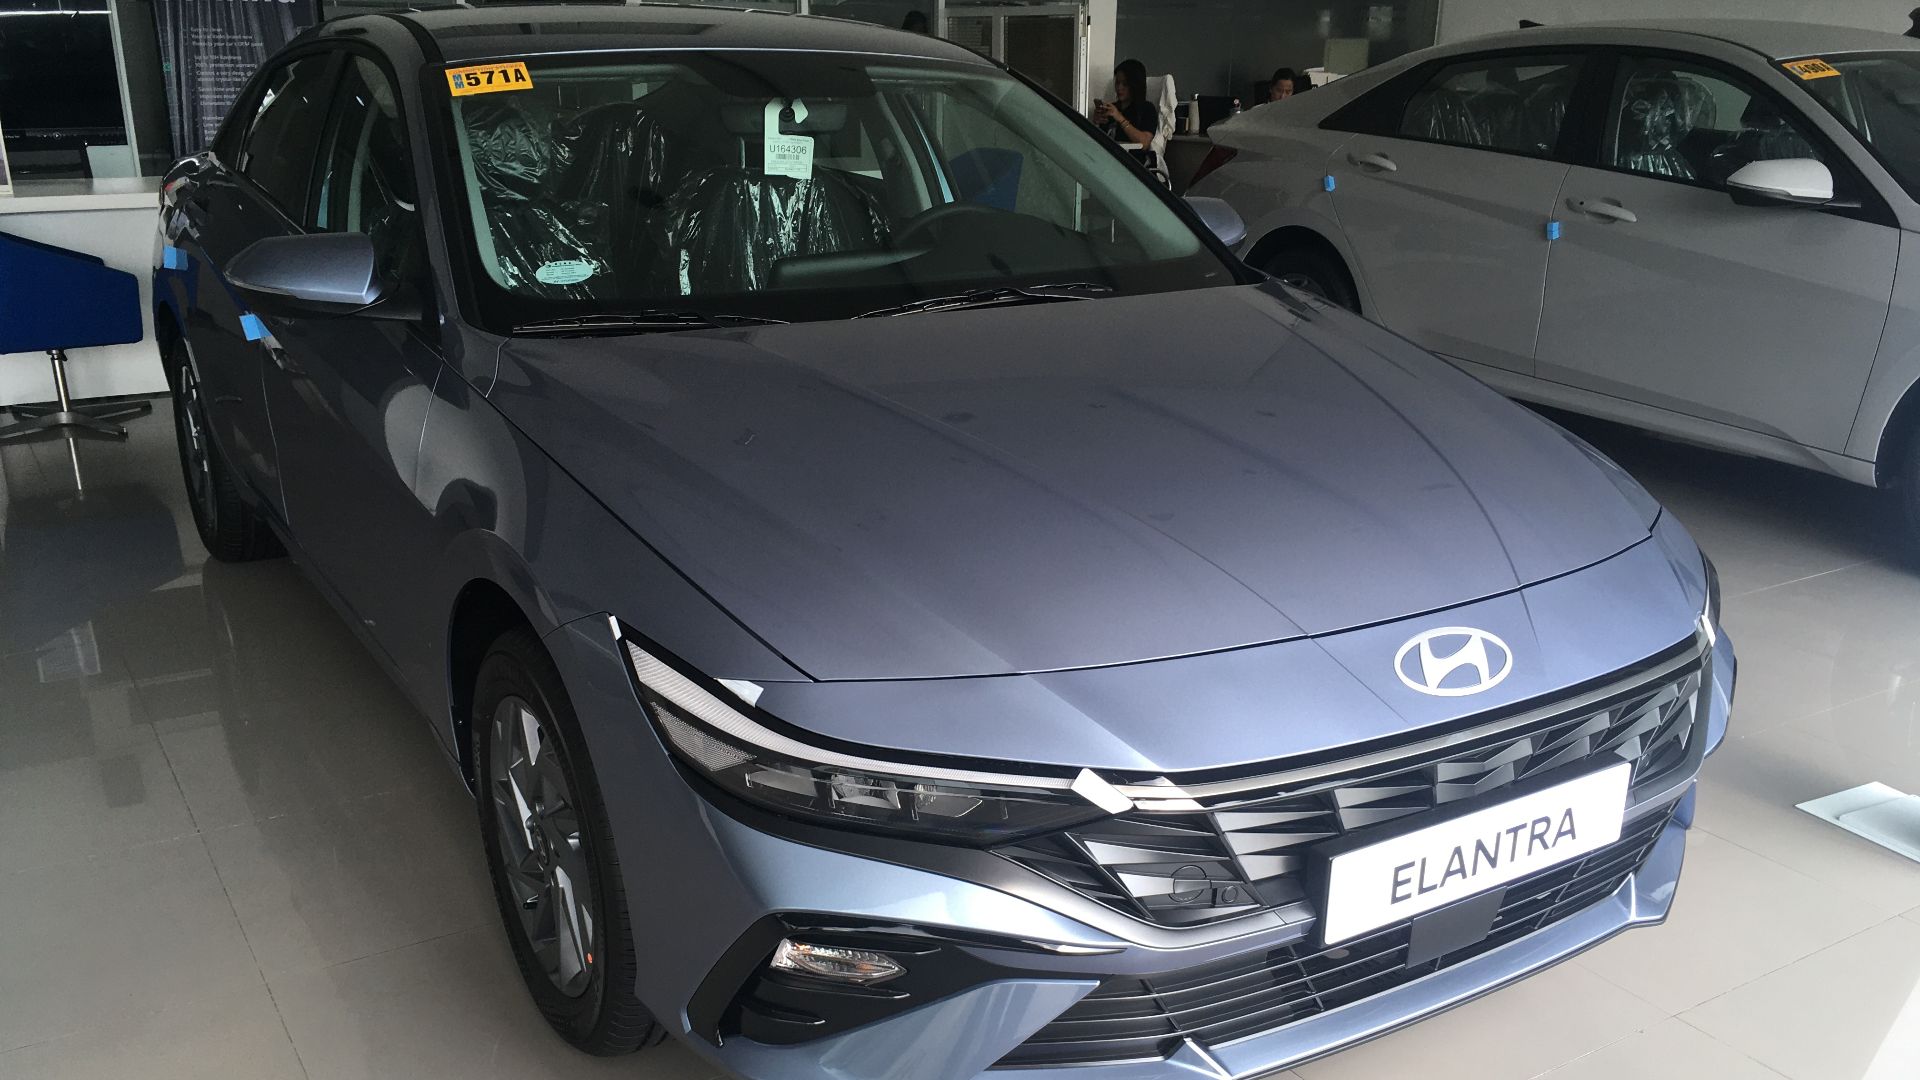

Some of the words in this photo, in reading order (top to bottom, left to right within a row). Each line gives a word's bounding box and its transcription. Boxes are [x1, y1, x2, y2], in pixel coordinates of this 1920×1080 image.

[465, 68, 527, 87] 571A
[769, 144, 807, 154] U164306
[1390, 807, 1577, 905] ELANTRA
